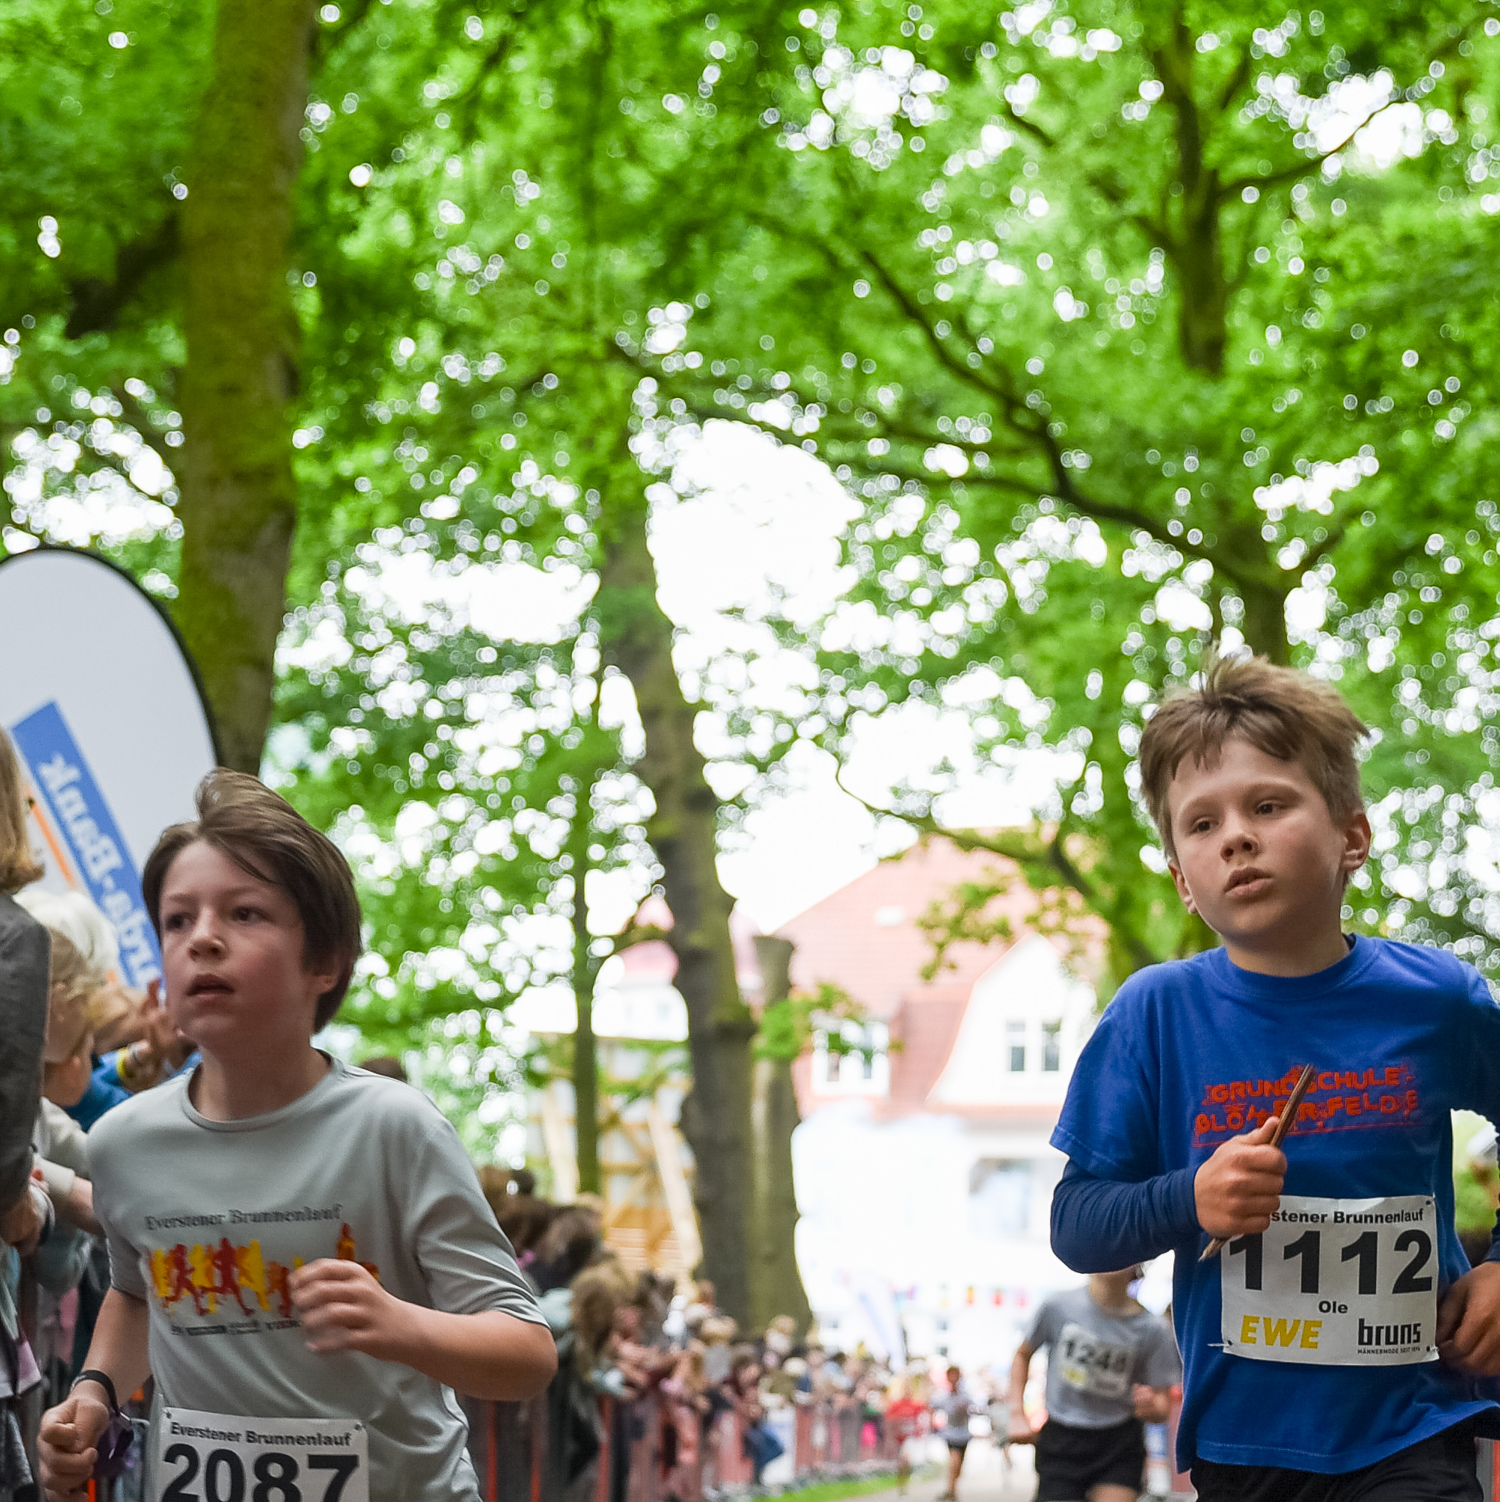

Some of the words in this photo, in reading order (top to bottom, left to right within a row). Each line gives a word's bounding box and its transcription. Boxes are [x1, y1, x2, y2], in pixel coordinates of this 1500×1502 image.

[228, 1203, 343, 1225] Brunnenlauf
[1271, 1211, 1328, 1224] stener
[1333, 1208, 1424, 1225] Brunnenlauf
[1229, 1229, 1433, 1295] 1112
[1318, 1300, 1349, 1314] Ole
[1240, 1314, 1323, 1350] EWE
[1358, 1318, 1421, 1346] bruns
[170, 1421, 243, 1442] Everstener
[246, 1430, 352, 1446] Brunnenlauf
